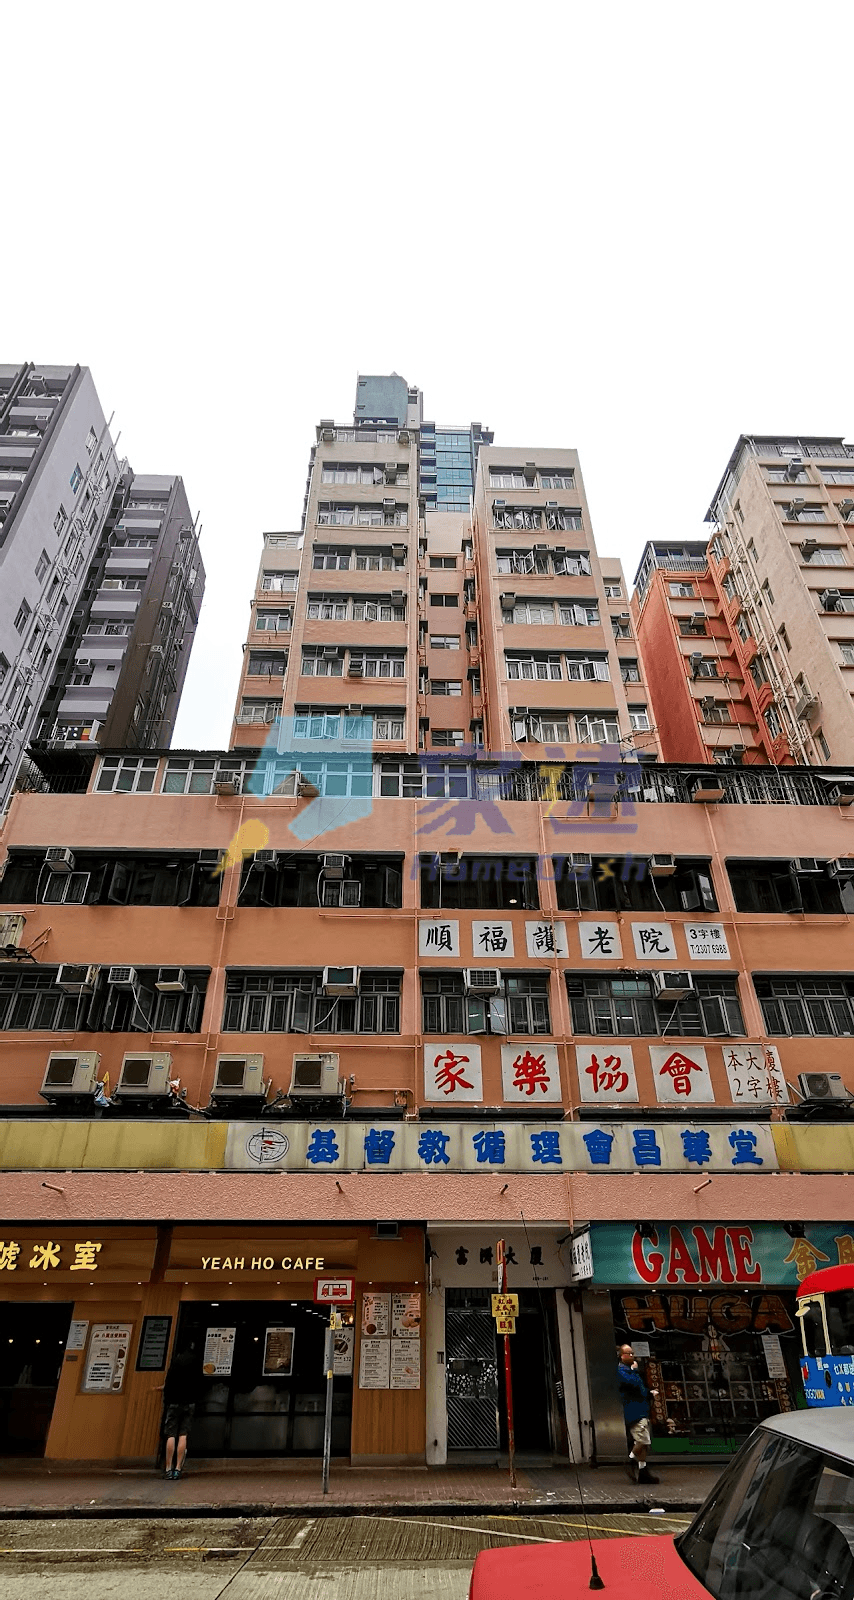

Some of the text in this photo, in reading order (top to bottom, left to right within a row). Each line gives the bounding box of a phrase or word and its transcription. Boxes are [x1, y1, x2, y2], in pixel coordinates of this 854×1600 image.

[425, 924, 670, 955] 順福護老院
[690, 929, 721, 939] 3字樓
[433, 1049, 703, 1096] 家樂協會
[727, 1050, 780, 1073] 本大廈
[736, 1078, 784, 1099] 2字樓
[305, 1127, 765, 1167] 基督教循理會昌華堂
[0, 1241, 102, 1271] 號冰室
[201, 1256, 325, 1270] YEAH HO CAFE
[631, 1225, 763, 1285] GAME
[621, 1294, 796, 1336] HUGA
